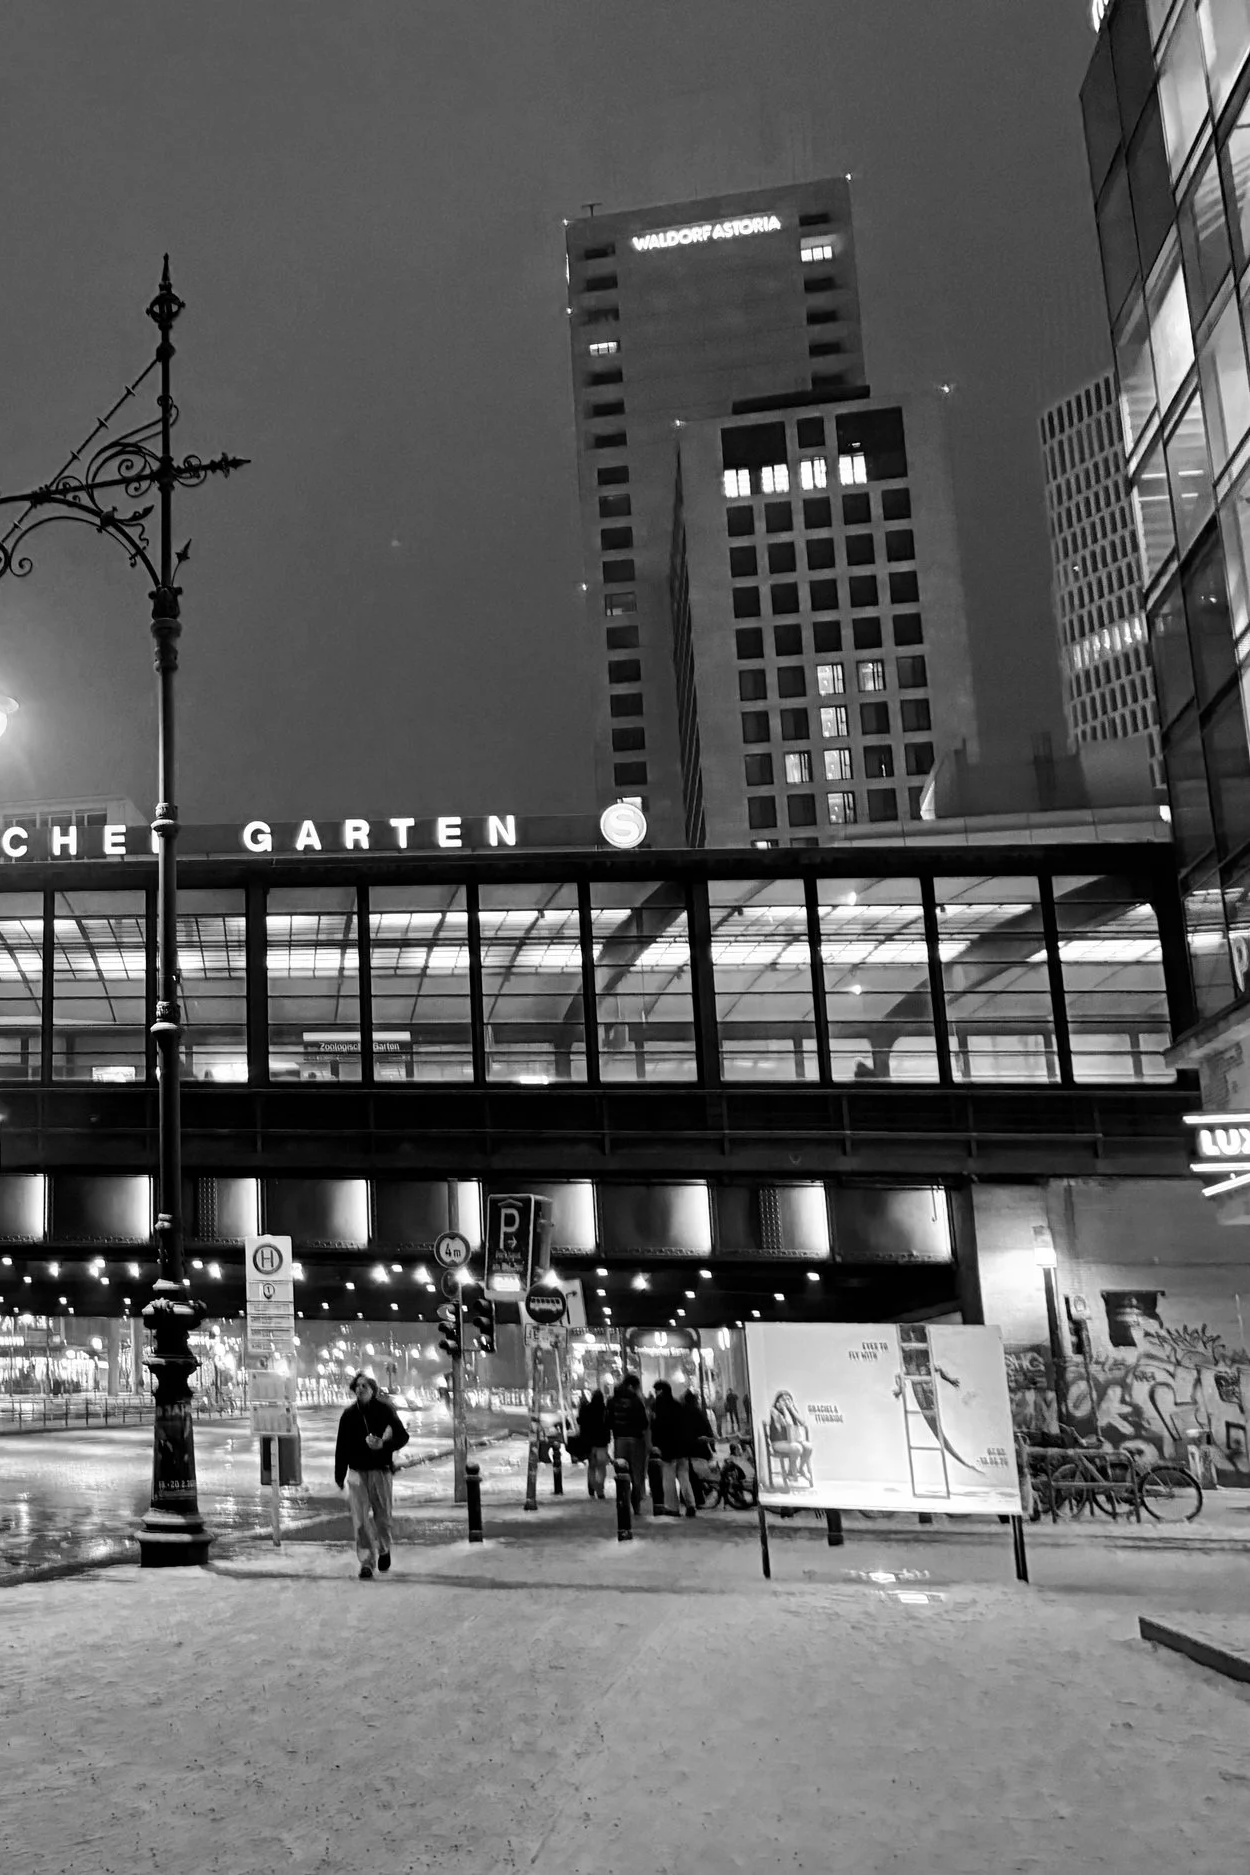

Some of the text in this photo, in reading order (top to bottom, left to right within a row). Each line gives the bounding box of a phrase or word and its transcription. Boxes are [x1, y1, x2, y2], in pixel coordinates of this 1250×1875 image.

[633, 215, 781, 250] WALDORF ASTORIA
[243, 815, 516, 852] GARTEN
[608, 807, 641, 845] S
[499, 1207, 520, 1249] P
[654, 1331, 668, 1347] U
